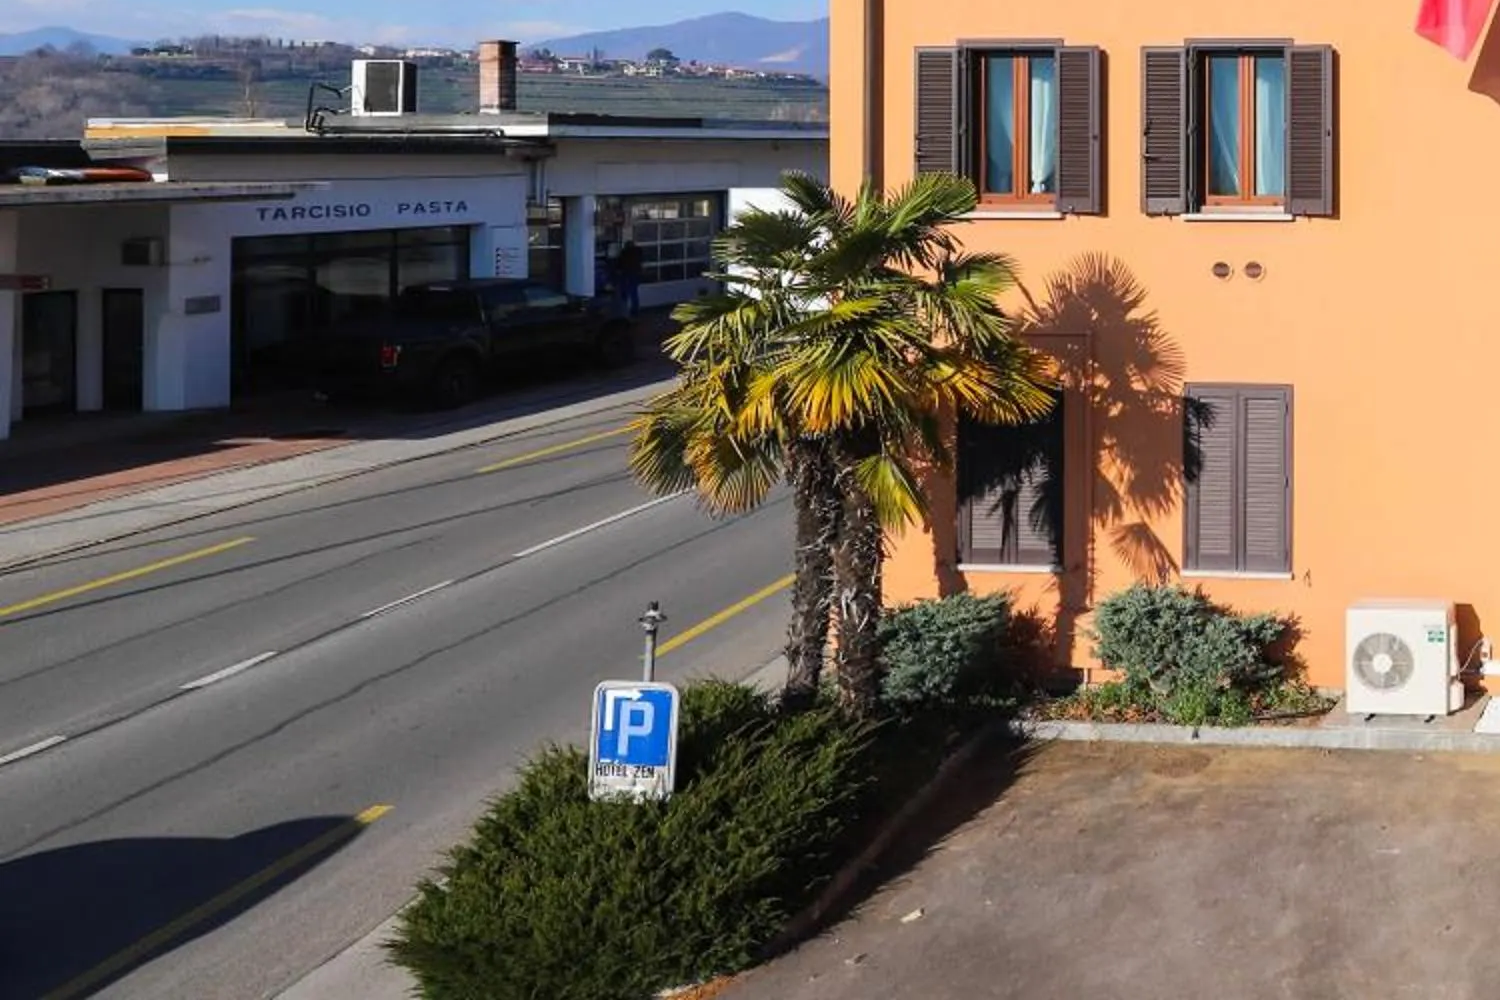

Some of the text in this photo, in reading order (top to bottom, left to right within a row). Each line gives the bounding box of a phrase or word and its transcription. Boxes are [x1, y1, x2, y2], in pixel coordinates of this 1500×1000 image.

[256, 200, 468, 221] TARCISIO PASTA
[618, 700, 655, 756] P
[595, 763, 655, 778] HOTEL ZEN
